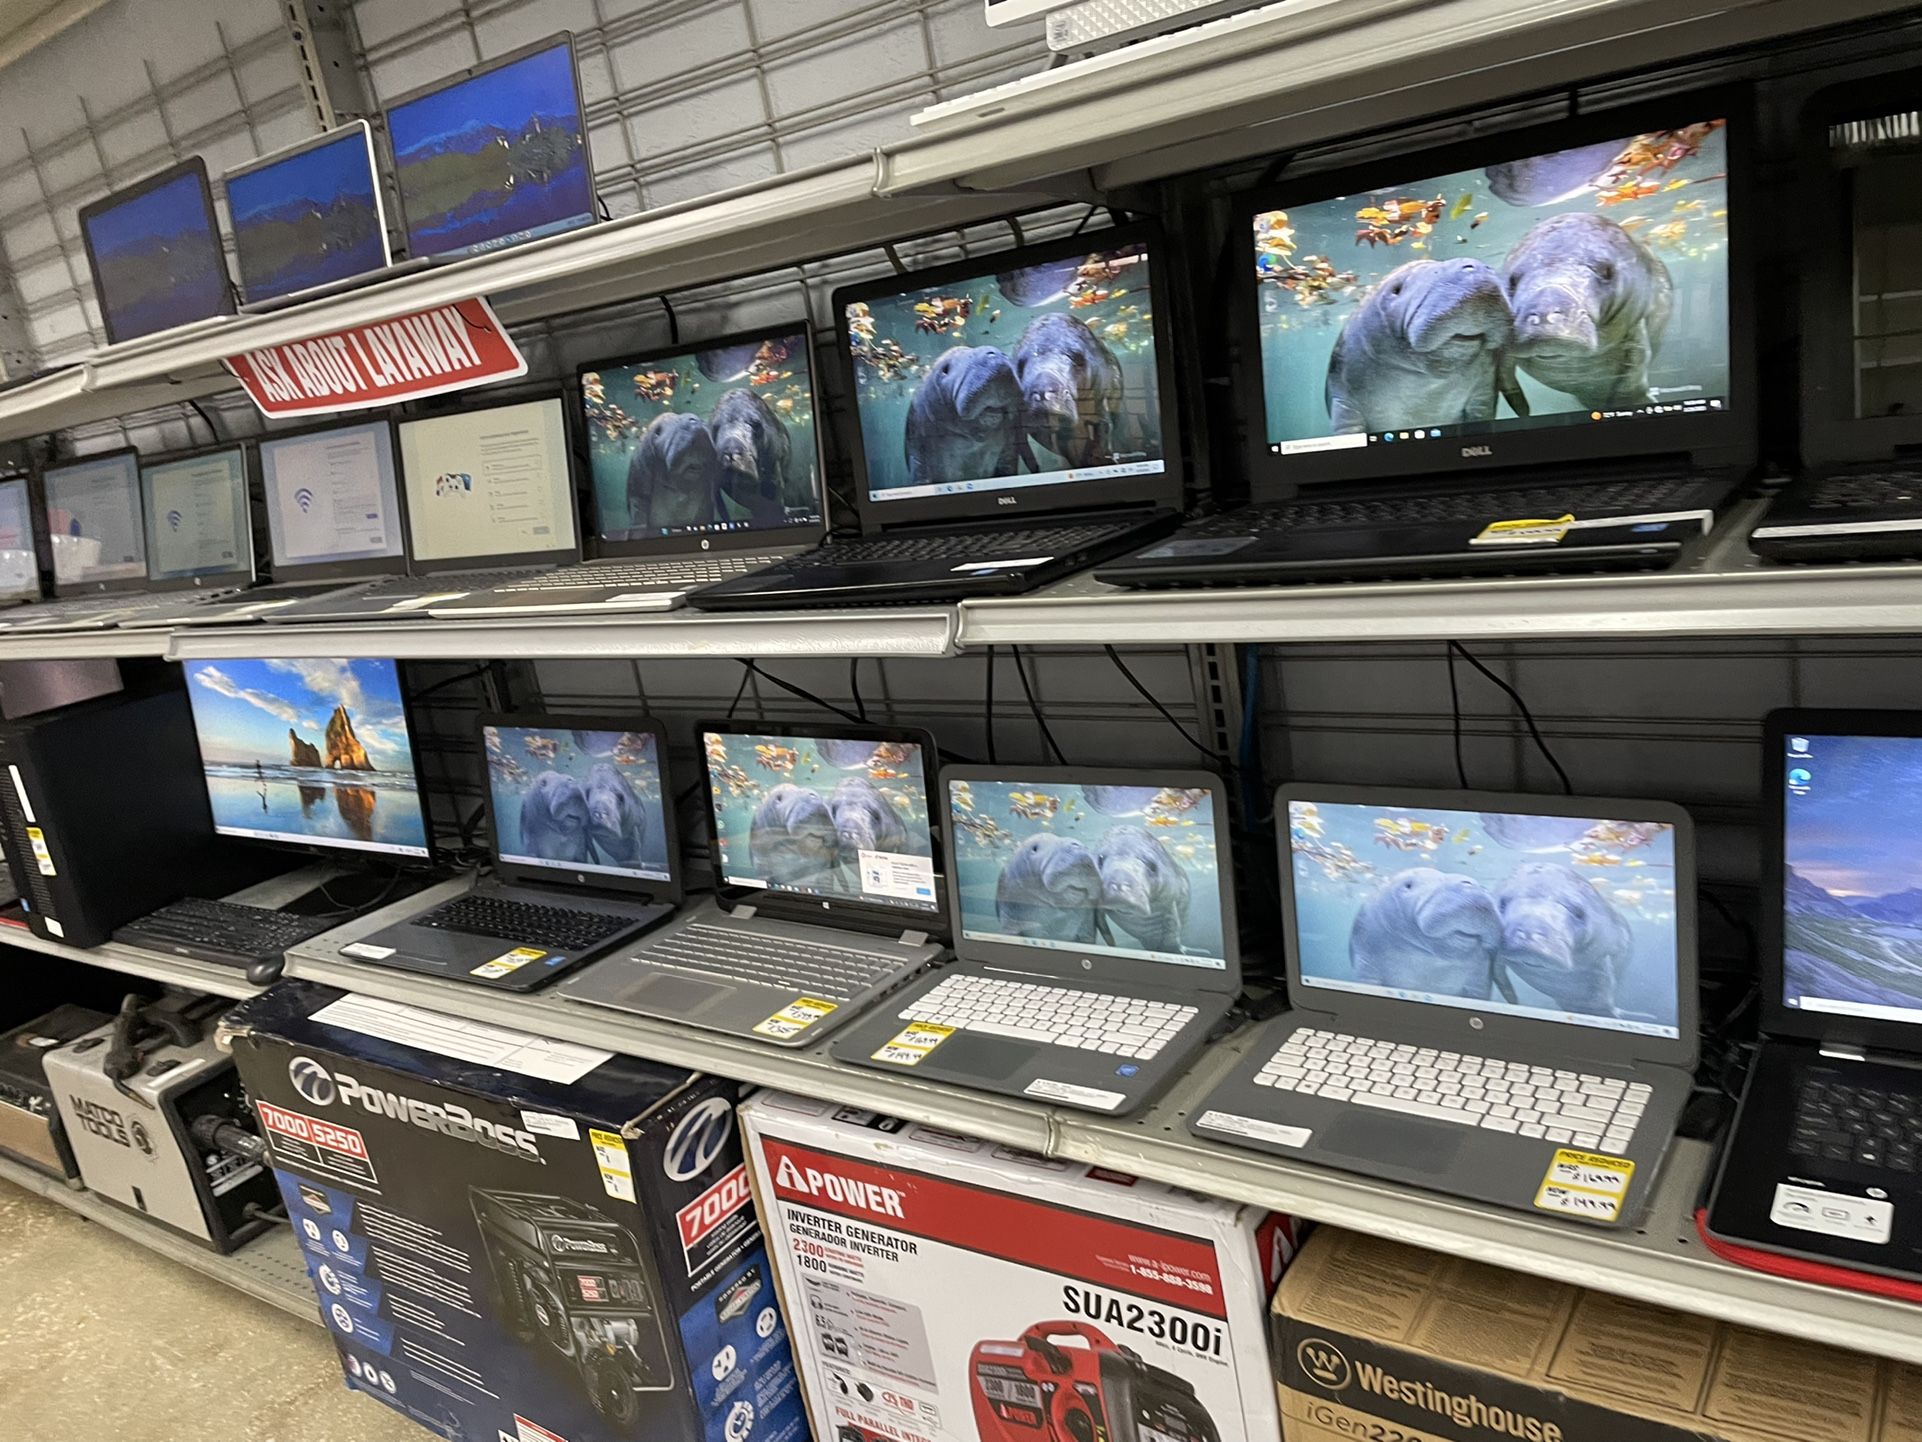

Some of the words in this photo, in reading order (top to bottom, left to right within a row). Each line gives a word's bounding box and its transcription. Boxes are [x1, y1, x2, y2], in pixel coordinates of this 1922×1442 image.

[245, 348, 305, 402] ASK
[287, 333, 368, 397] ABOUT
[361, 306, 482, 388] LAYAWAY
[69, 1094, 124, 1128] MATCO
[76, 1112, 131, 1148] TOOLS
[262, 1107, 308, 1137] 7000
[312, 1122, 361, 1154] 5250
[787, 1208, 842, 1234] INVERTER
[846, 1225, 918, 1255] GENERATOR
[789, 1223, 847, 1250] GENERADOR
[850, 1240, 899, 1262] INVERTER
[793, 1238, 825, 1258] 2300
[797, 1254, 827, 1273] 1800
[1063, 1285, 1222, 1356] SUA2300i
[1307, 1401, 1422, 1442] iGen22
[1355, 1360, 1564, 1442] Westinghouse
